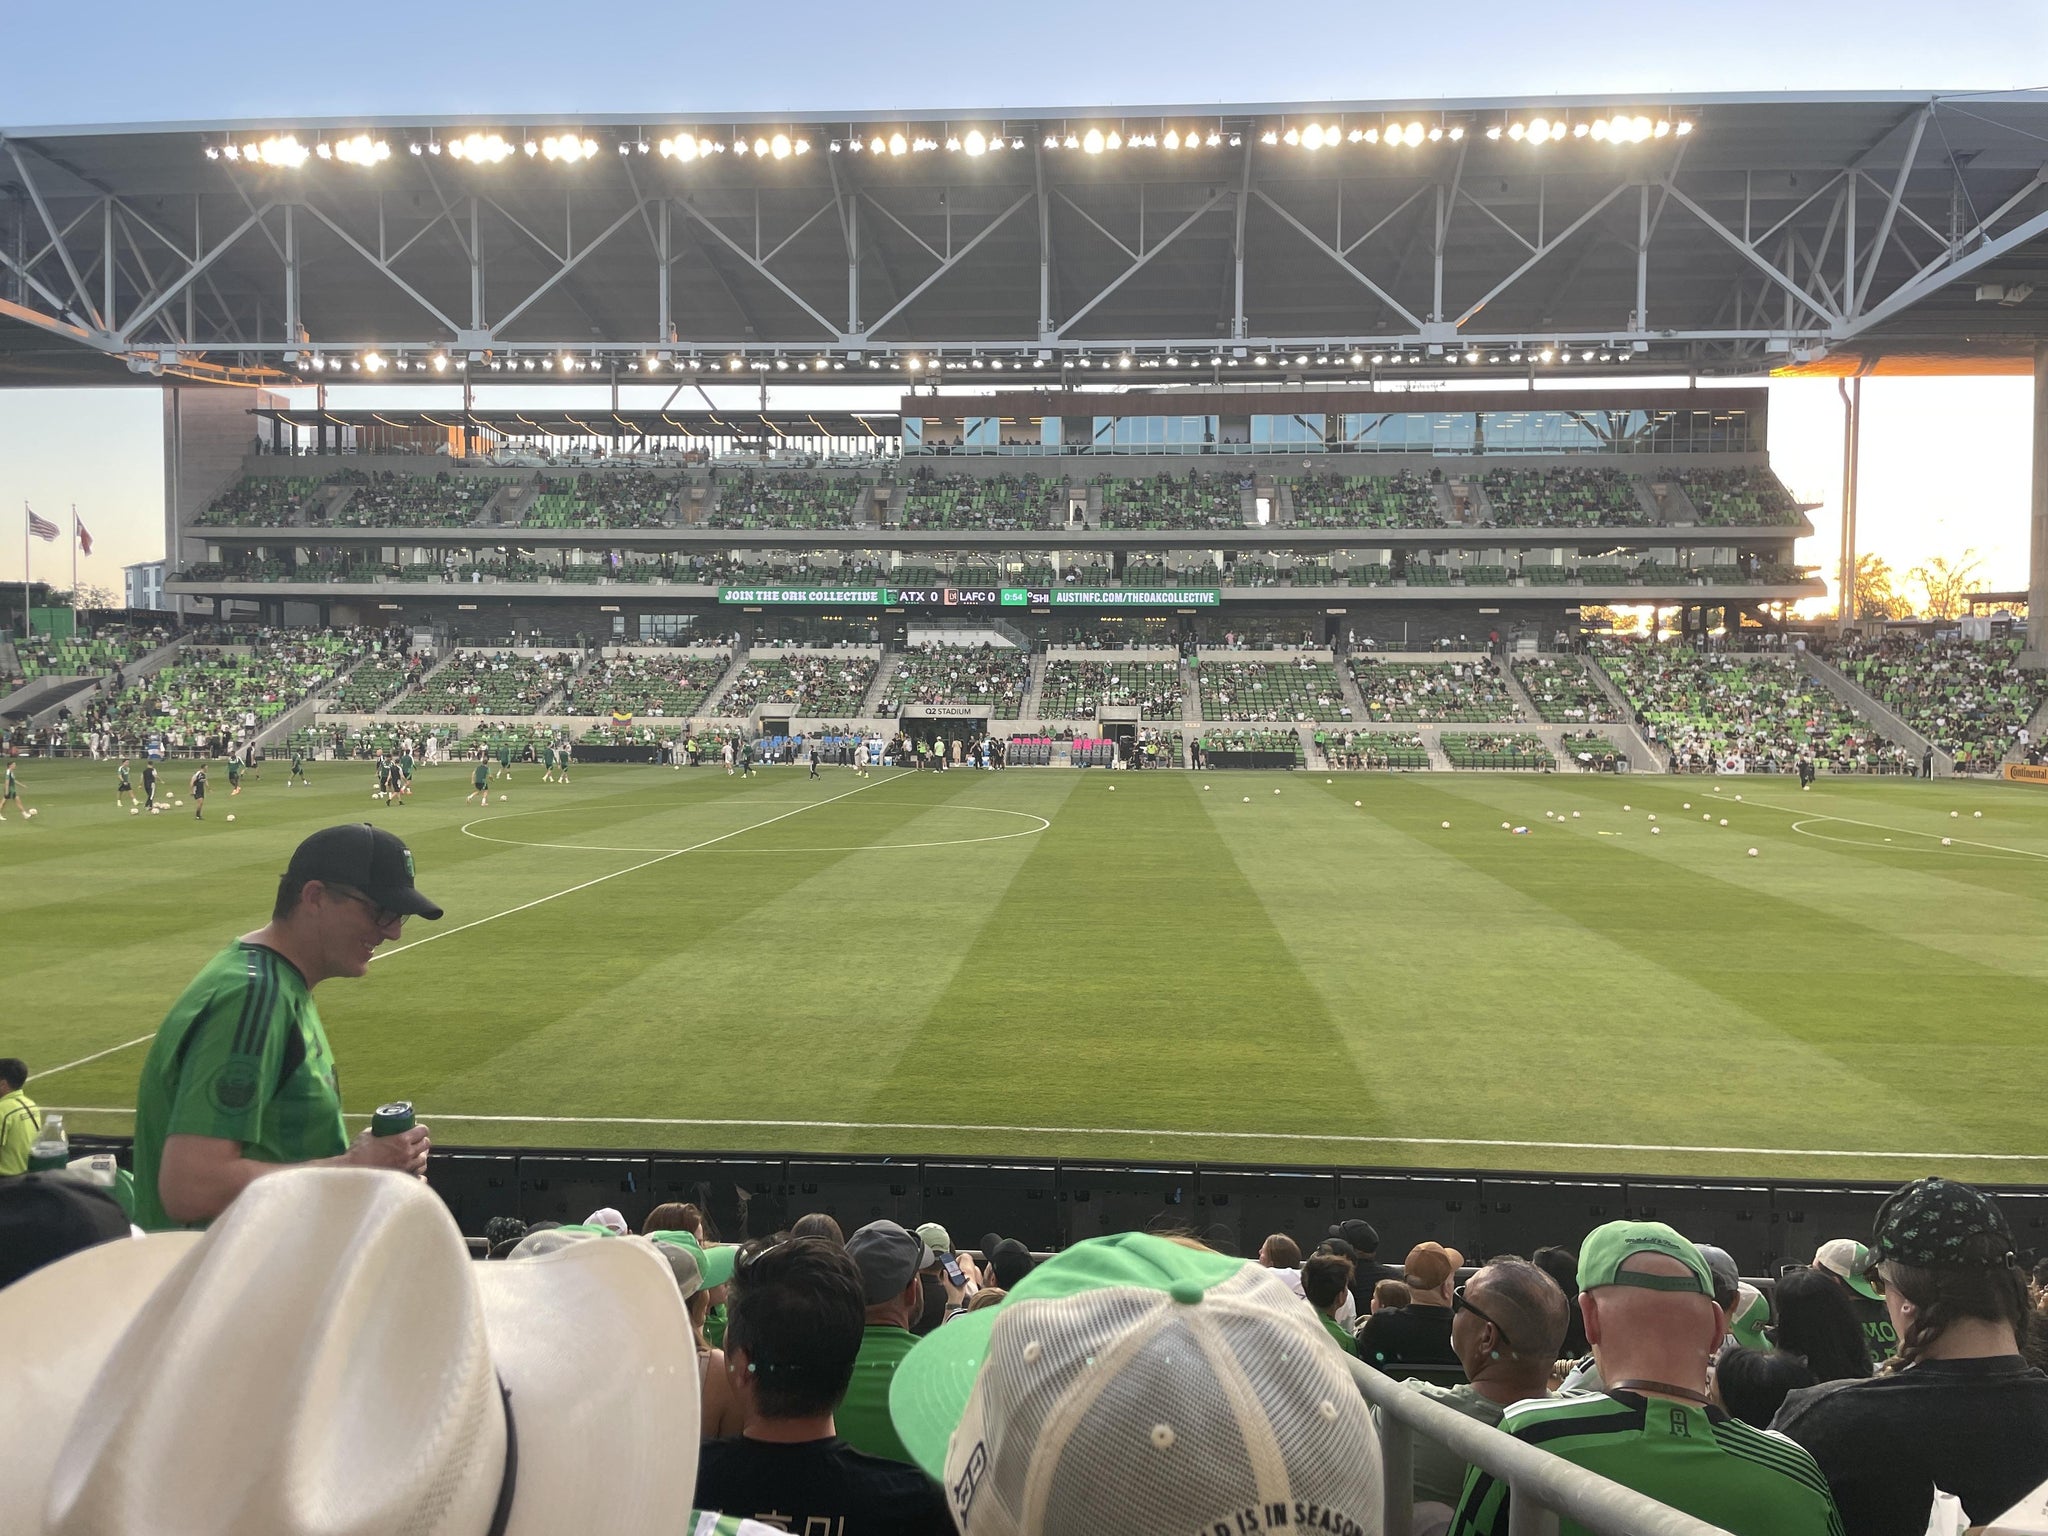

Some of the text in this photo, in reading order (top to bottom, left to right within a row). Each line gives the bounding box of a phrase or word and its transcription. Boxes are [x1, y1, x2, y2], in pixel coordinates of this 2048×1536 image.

[724, 590, 878, 602] JOIN THE OAK COLLECTIVE
[899, 591, 939, 602] ATX 0
[960, 592, 996, 602] LAFC 0
[1056, 592, 1215, 604] AUSTINFC.COM/THEOAKCOLLECTIVE
[925, 707, 972, 716] Q2 STADIUM
[2010, 765, 2047, 780] Continental
[1235, 1507, 1260, 1535] IS
[1264, 1502, 1289, 1528] IN
